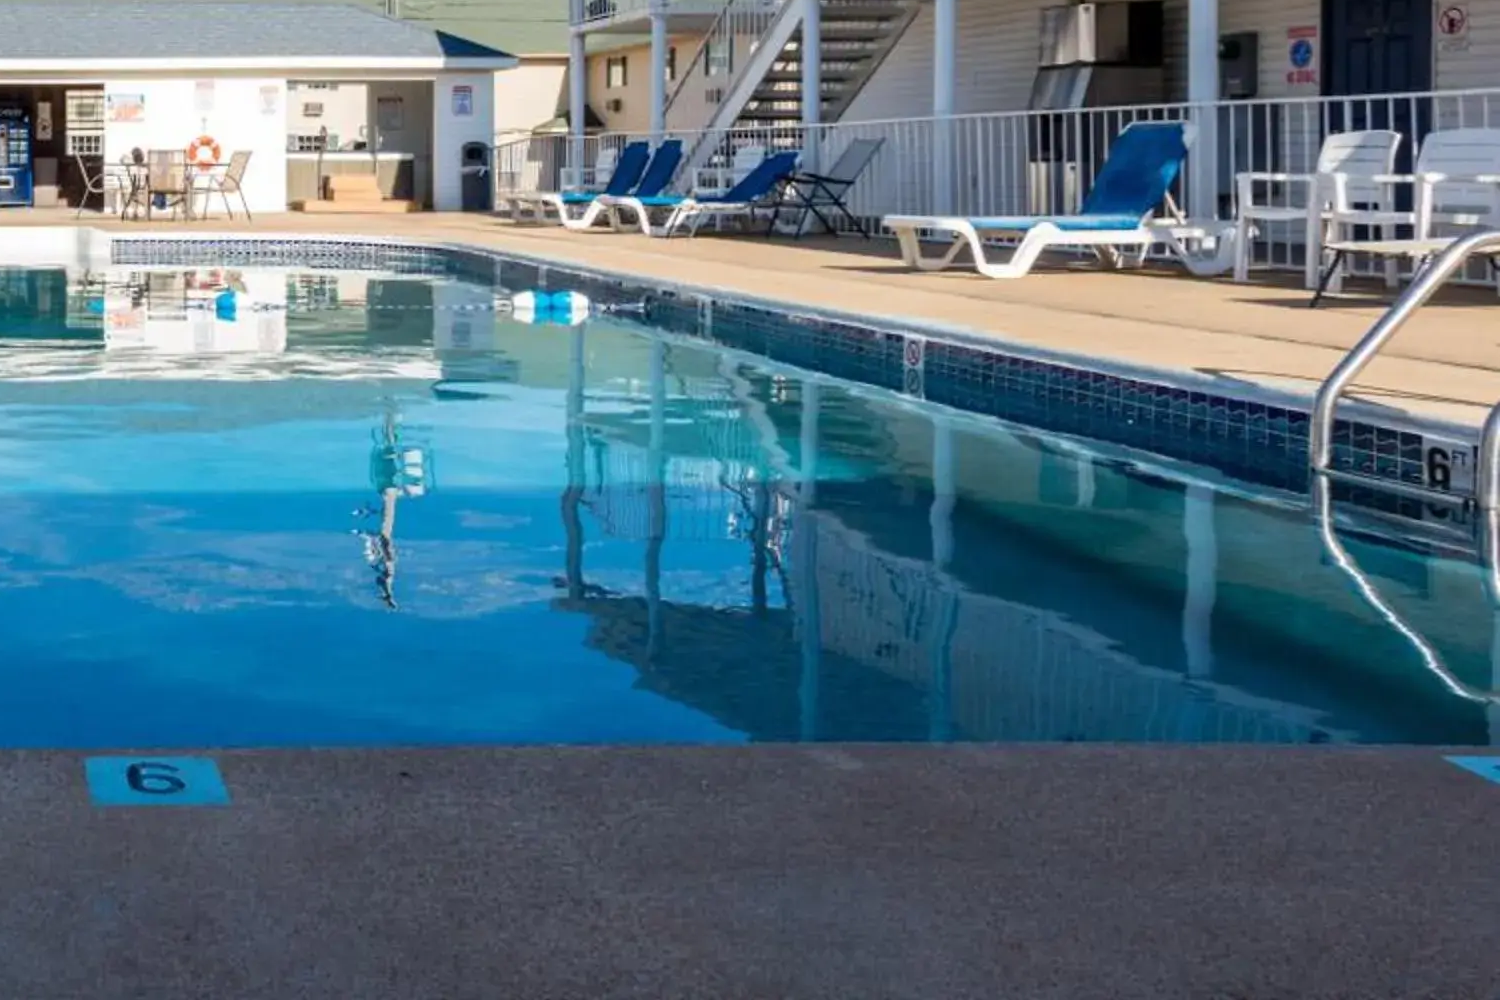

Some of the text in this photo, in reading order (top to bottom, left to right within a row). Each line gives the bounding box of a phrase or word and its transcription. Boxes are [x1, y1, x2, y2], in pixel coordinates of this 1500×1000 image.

[1428, 446, 1467, 485] 6 FT
[126, 761, 186, 794] 6
